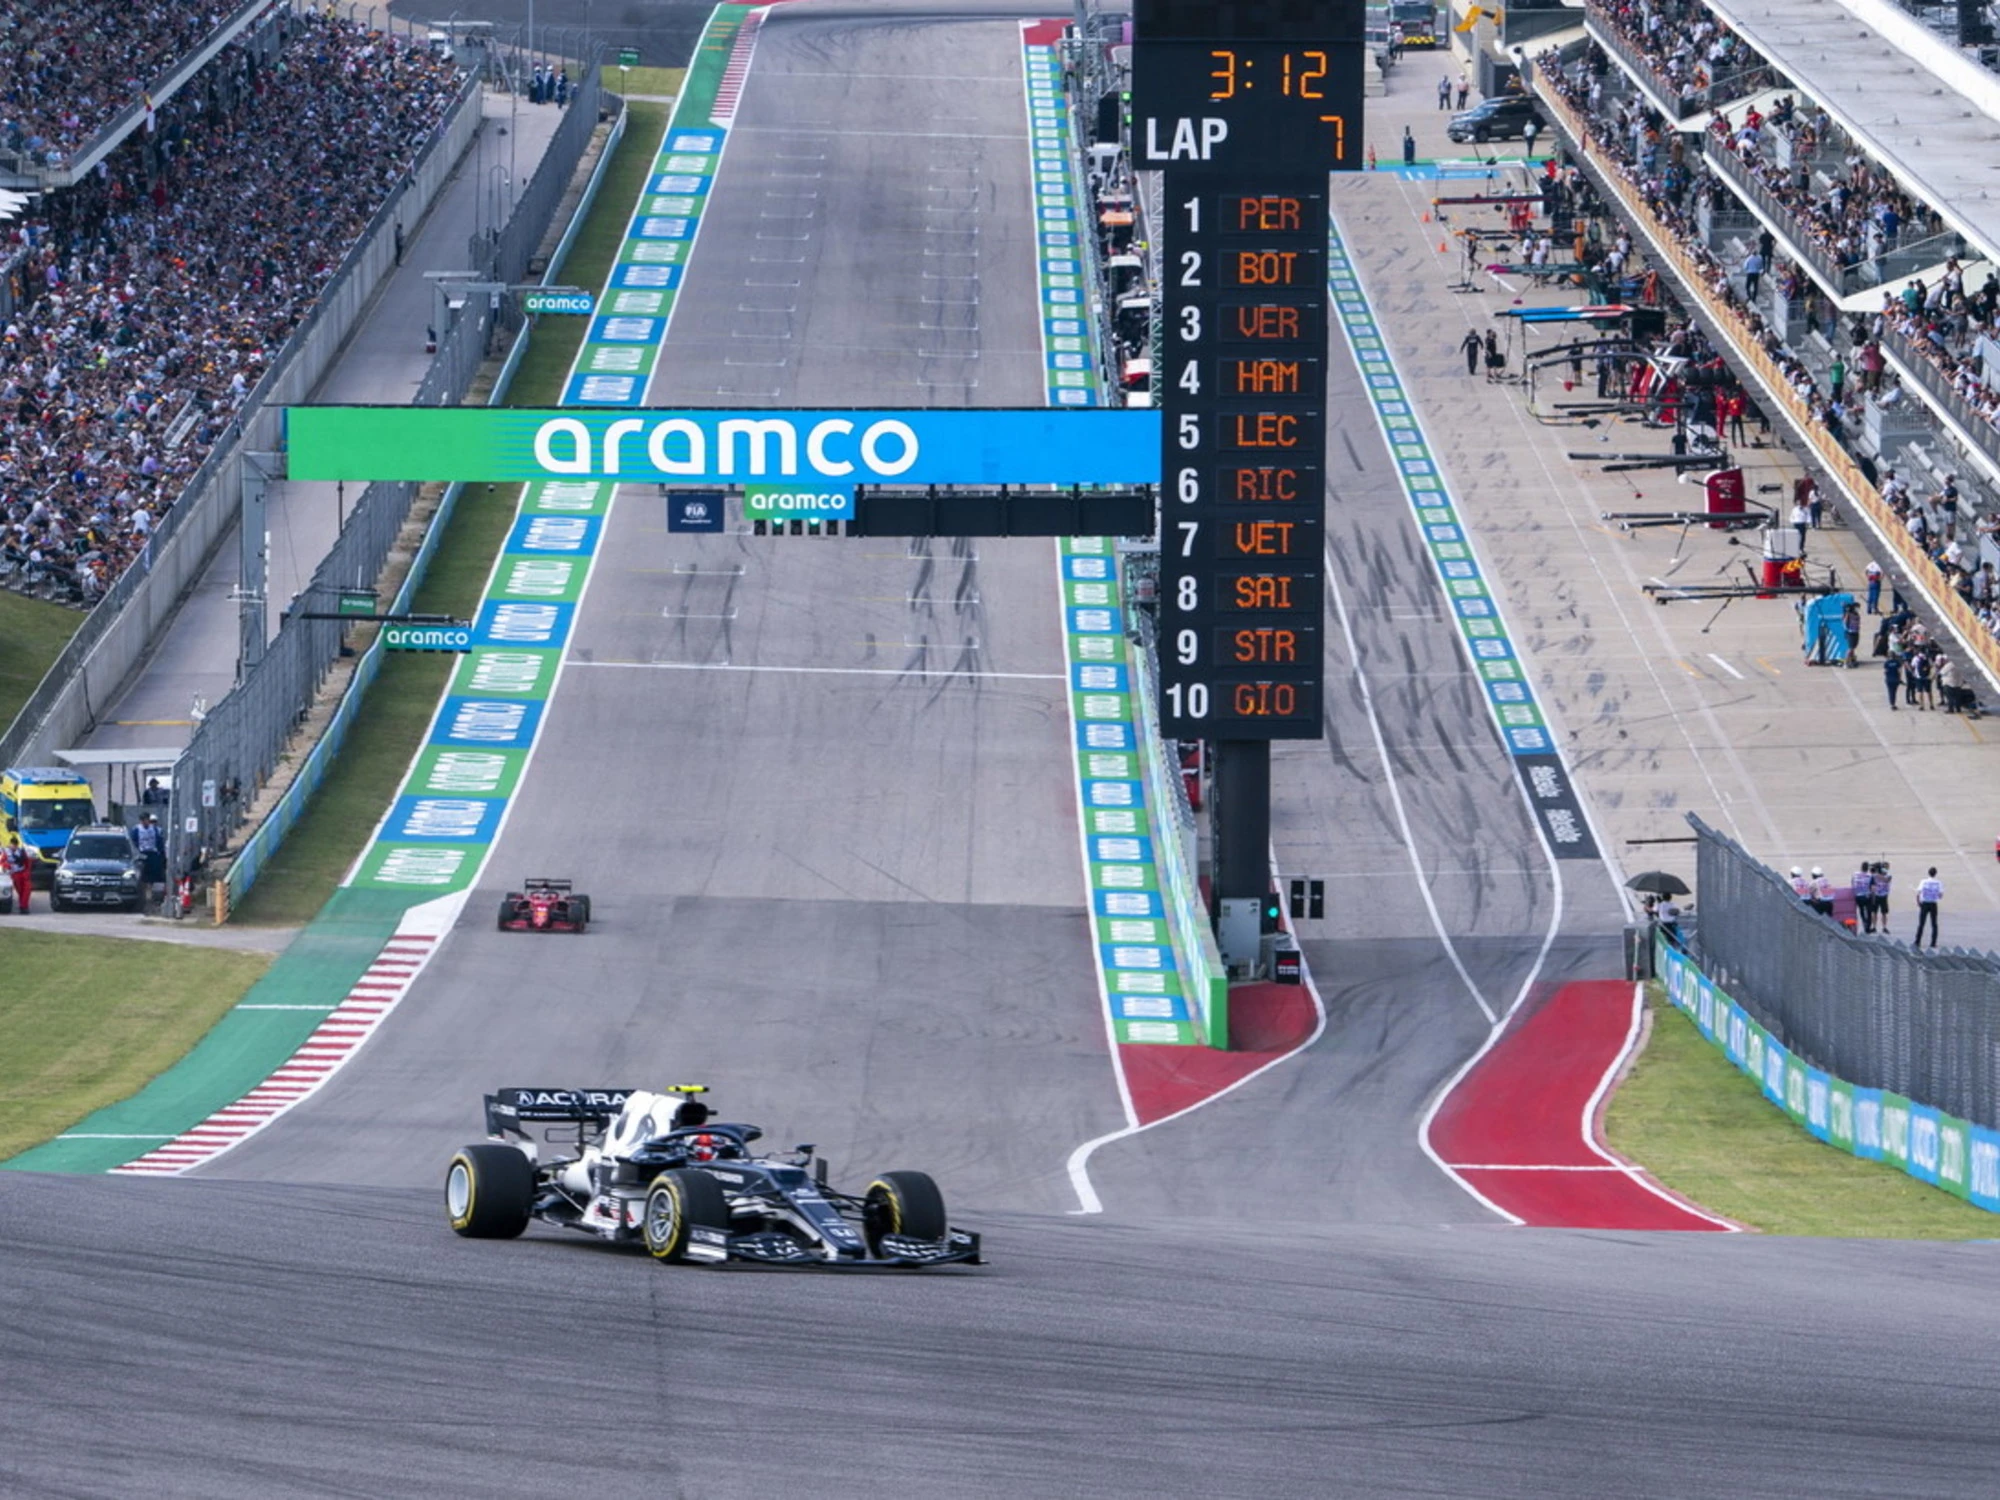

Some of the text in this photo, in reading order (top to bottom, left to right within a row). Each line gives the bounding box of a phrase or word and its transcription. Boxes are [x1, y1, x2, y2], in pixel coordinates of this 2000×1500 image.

[1146, 115, 1345, 161] LAP 7
[1184, 198, 1299, 232] 1 PER
[1181, 251, 1297, 286] 2 BOT
[527, 298, 591, 310] aramco
[1181, 306, 1298, 341] 3 VER
[1180, 361, 1298, 394] 4 HAM
[534, 418, 919, 477] aramco
[1180, 414, 1297, 449] 5 LEC
[750, 493, 847, 510] aramco
[1178, 468, 1297, 503] 6 RIC
[1178, 522, 1293, 556] 7 VET
[1177, 576, 1292, 610] 8 SAI
[386, 630, 469, 646] aramco
[1177, 630, 1295, 664] 9 STR
[1165, 684, 1295, 718] 10 GIO
